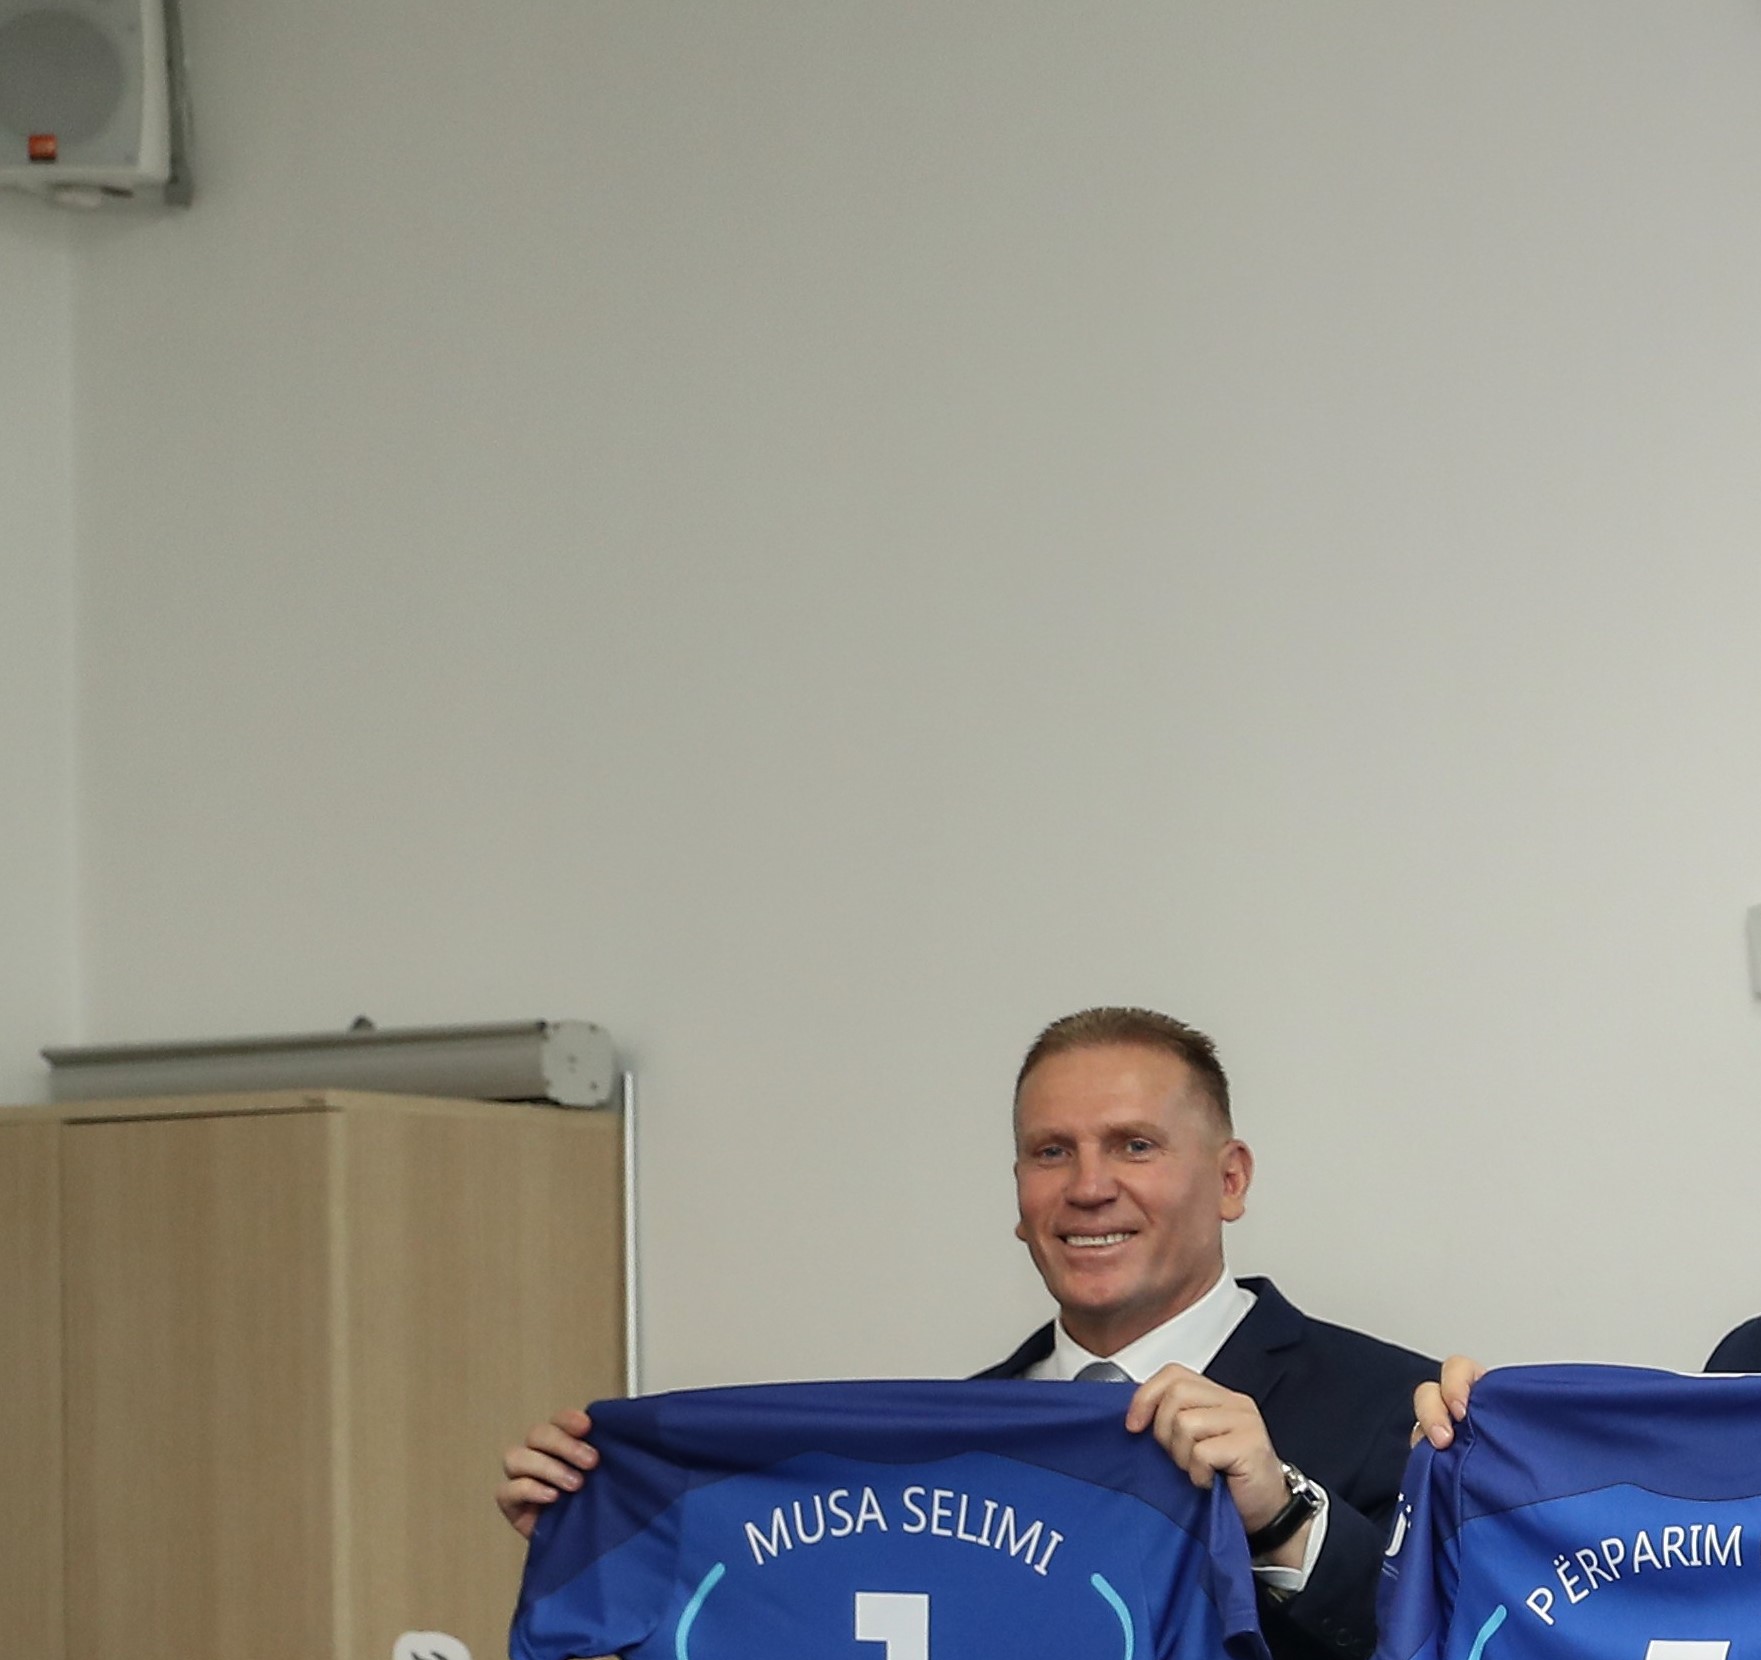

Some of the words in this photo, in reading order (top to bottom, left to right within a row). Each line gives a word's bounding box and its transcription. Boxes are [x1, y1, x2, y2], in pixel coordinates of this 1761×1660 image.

[744, 1486, 889, 1566] MUSA
[902, 1486, 1064, 1576] SELIMI
[1524, 1522, 1744, 1628] PËRPARIM
